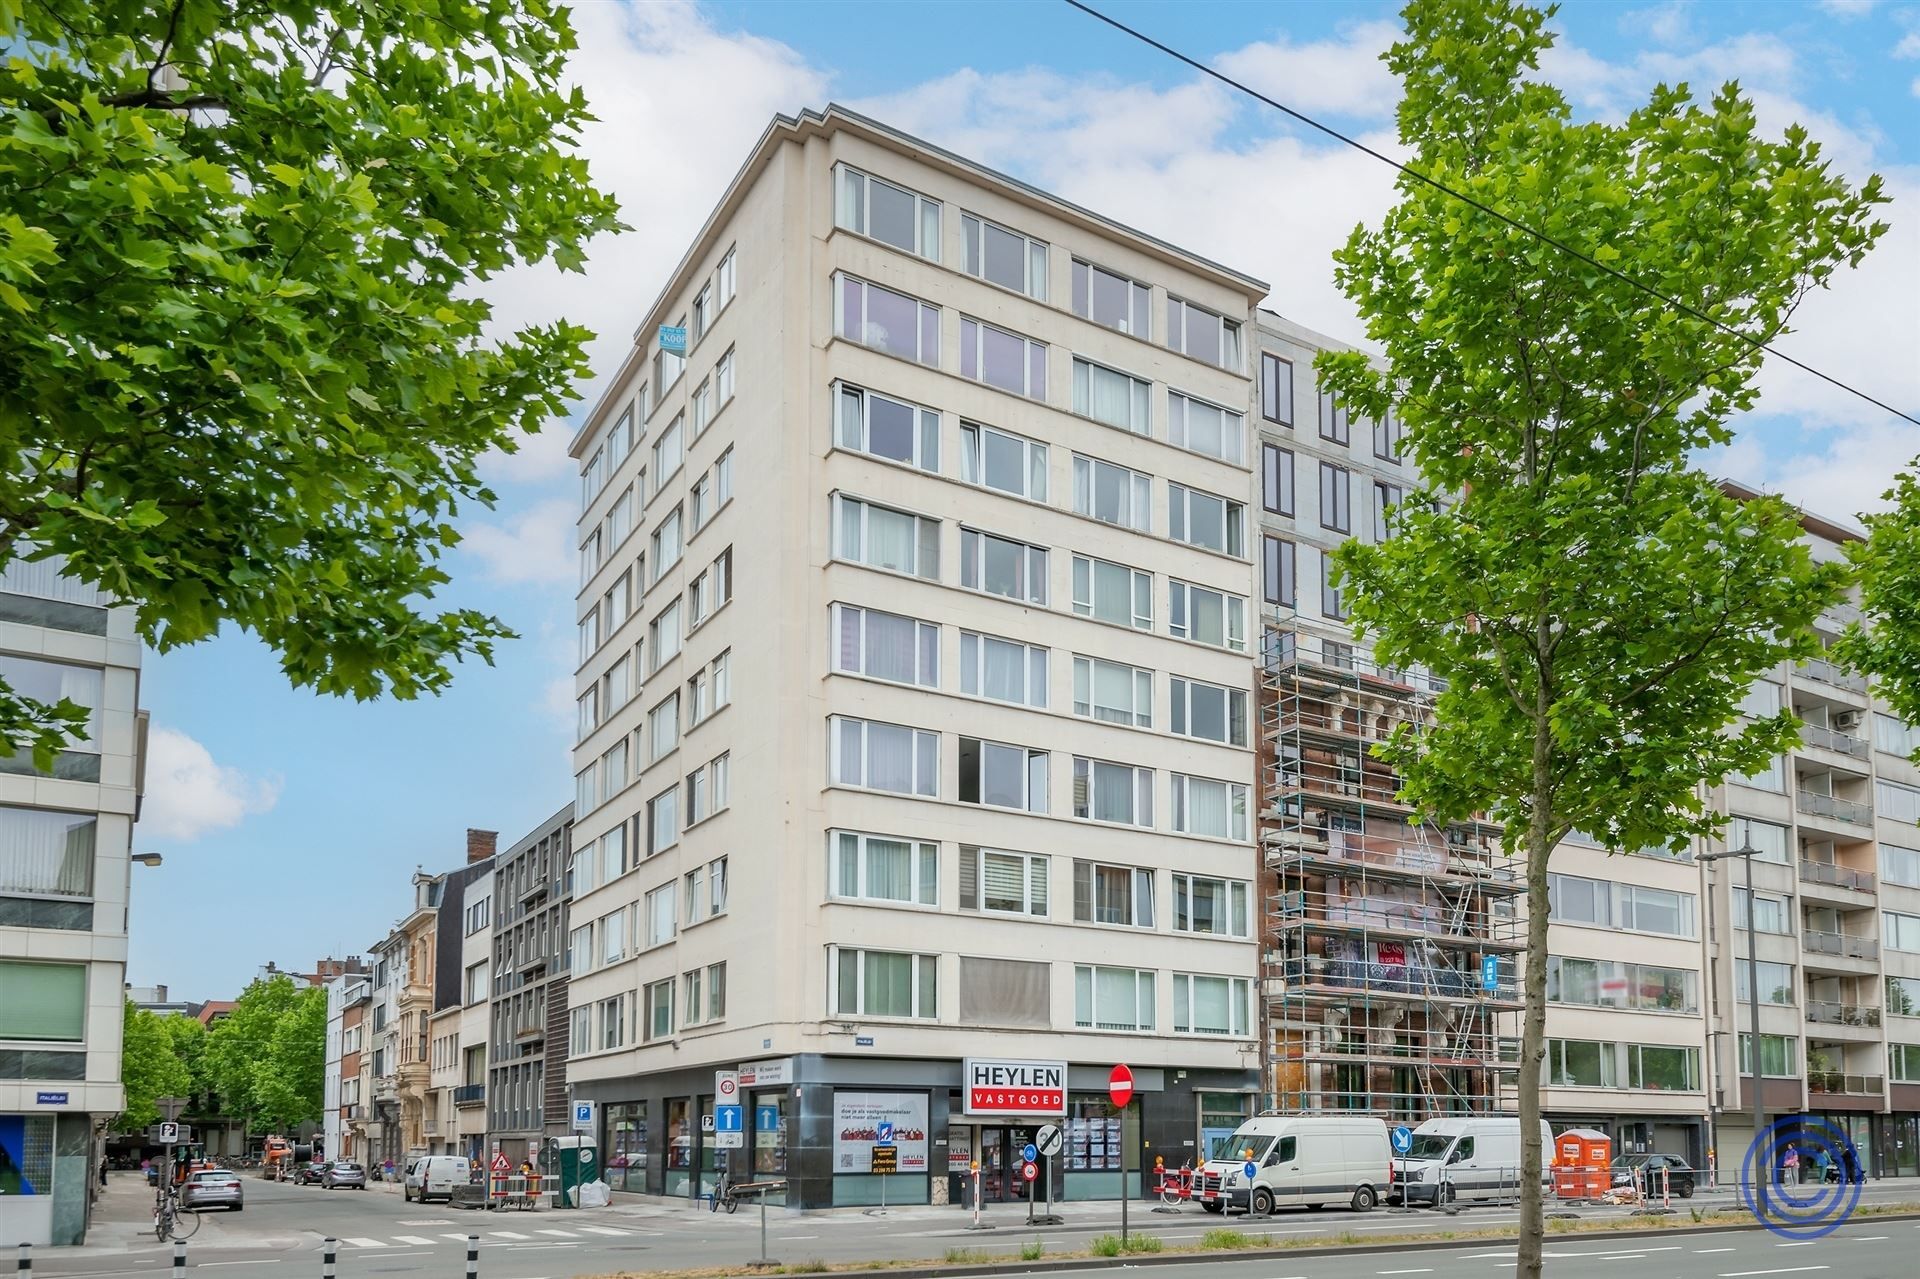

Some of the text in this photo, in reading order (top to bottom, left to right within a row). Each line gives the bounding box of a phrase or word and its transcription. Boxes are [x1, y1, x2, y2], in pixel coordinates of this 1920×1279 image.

[974, 1066, 1060, 1087] HEYLEN
[723, 1083, 733, 1091] 30
[974, 1093, 1060, 1105] VASTGOED
[580, 1107, 588, 1118] P
